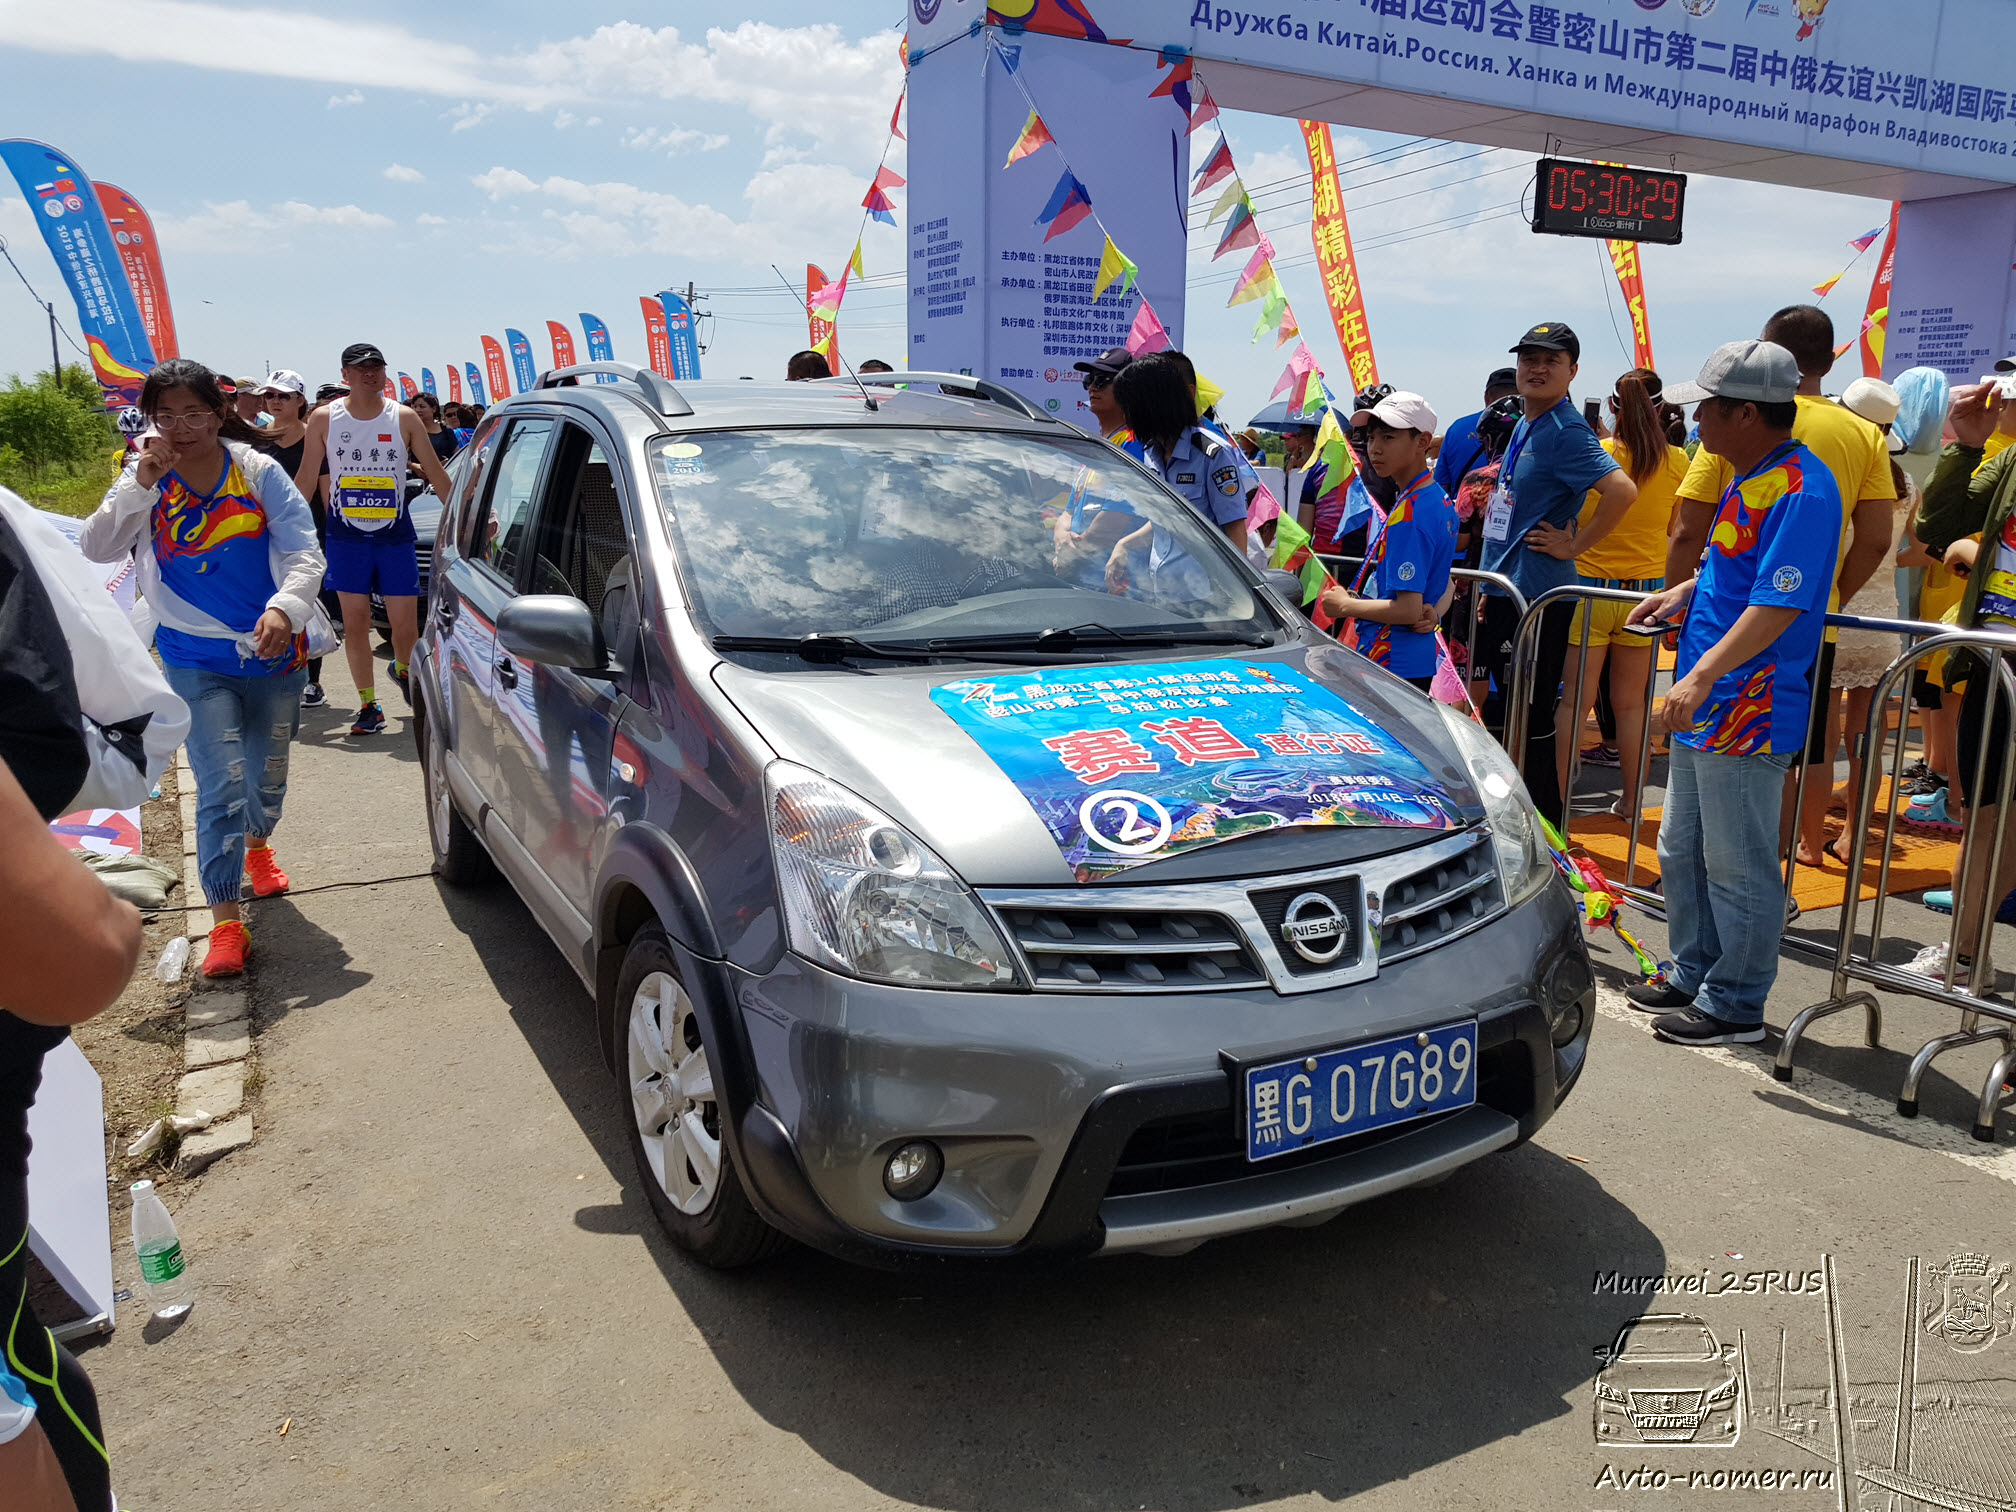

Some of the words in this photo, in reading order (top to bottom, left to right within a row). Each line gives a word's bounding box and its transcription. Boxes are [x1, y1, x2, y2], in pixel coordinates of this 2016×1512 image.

[1190, 0, 1308, 41] Дружба
[1507, 55, 1577, 88] Ханка
[1584, 73, 1597, 91] и
[1604, 72, 1791, 123] Международный
[1794, 109, 1880, 137] марафон
[1885, 119, 2008, 156] Владивостока
[1549, 167, 1678, 221] 05:30:29
[1044, 253, 1101, 268] 黑龙江省体育局
[1302, 120, 1374, 393] 凯湖精彩在密
[1044, 280, 1140, 296] 黑龙江省田径动管理中心
[1043, 306, 1125, 321] 密山市文化广电体育局
[336, 447, 398, 462] 中国警察
[673, 466, 700, 474] 2019
[346, 496, 390, 507] 警J027
[1022, 671, 1242, 699] 黑龙江省第14届运动会
[984, 683, 1303, 718] 密山市第二届中俄友谊兴凯湖国际
[1105, 696, 1233, 715] 马拉松比赛
[1041, 715, 1260, 786] 赛道
[1255, 730, 1385, 756] 通行证
[1327, 774, 1395, 787] 赛事组委会
[1292, 916, 1347, 938] NISSAN
[1254, 1073, 1312, 1145] 黑G
[1330, 1037, 1471, 1124] 07G89
